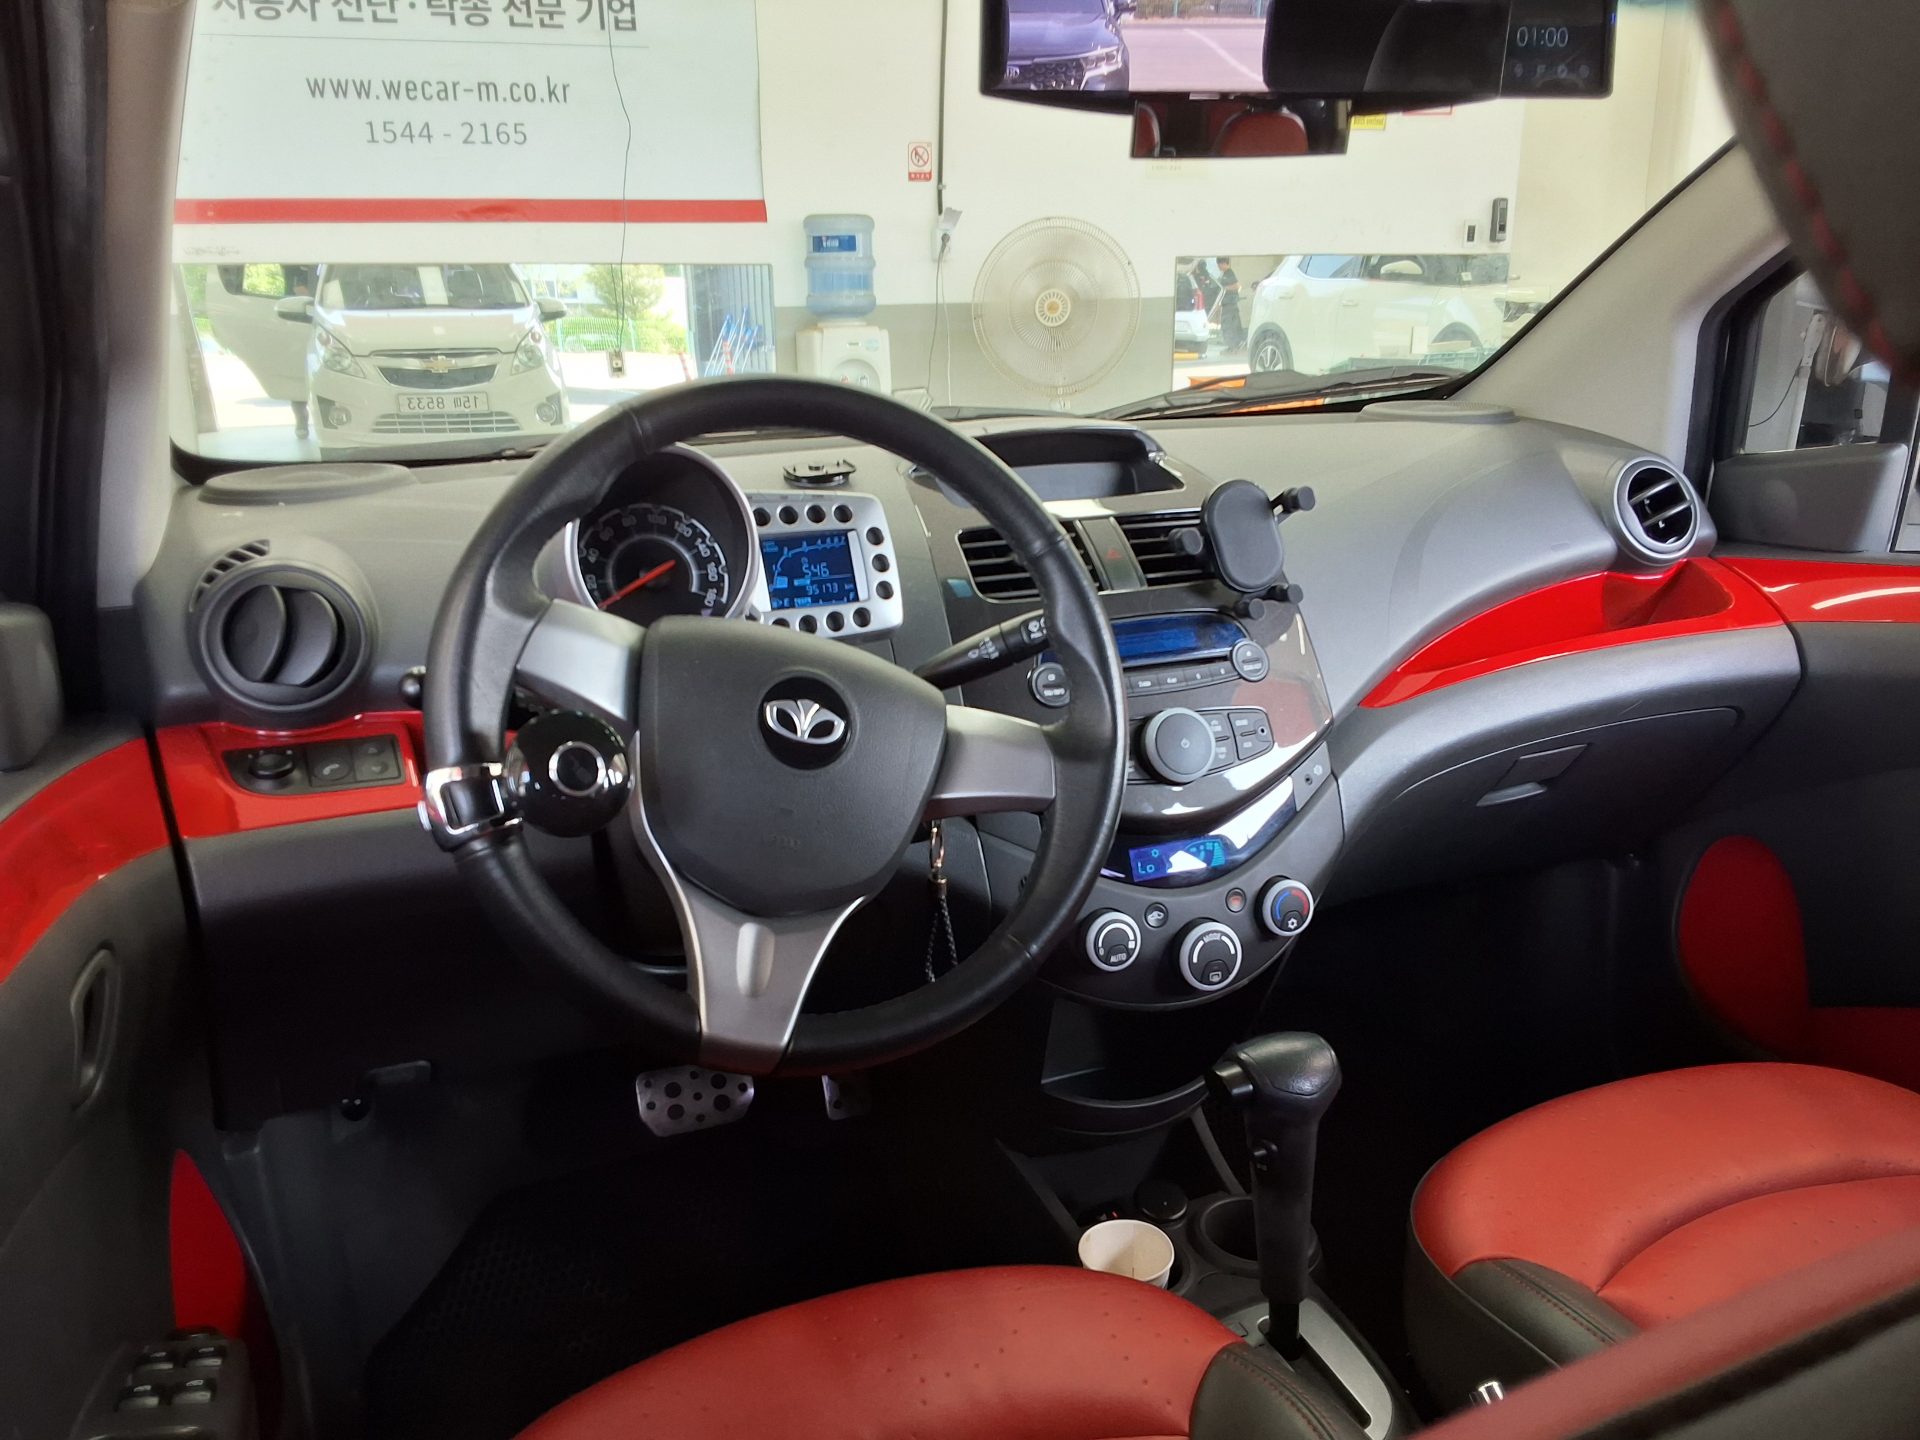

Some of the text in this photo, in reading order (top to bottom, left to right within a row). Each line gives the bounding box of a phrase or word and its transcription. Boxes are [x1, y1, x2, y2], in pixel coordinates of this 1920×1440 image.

[576, 0, 638, 31] 기업
[1516, 26, 1569, 47] 01:00
[305, 75, 571, 104] www.wecar-m.co.kr
[365, 121, 433, 144] 1544
[460, 122, 528, 145] 2165
[1109, 952, 1127, 963] AUTO
